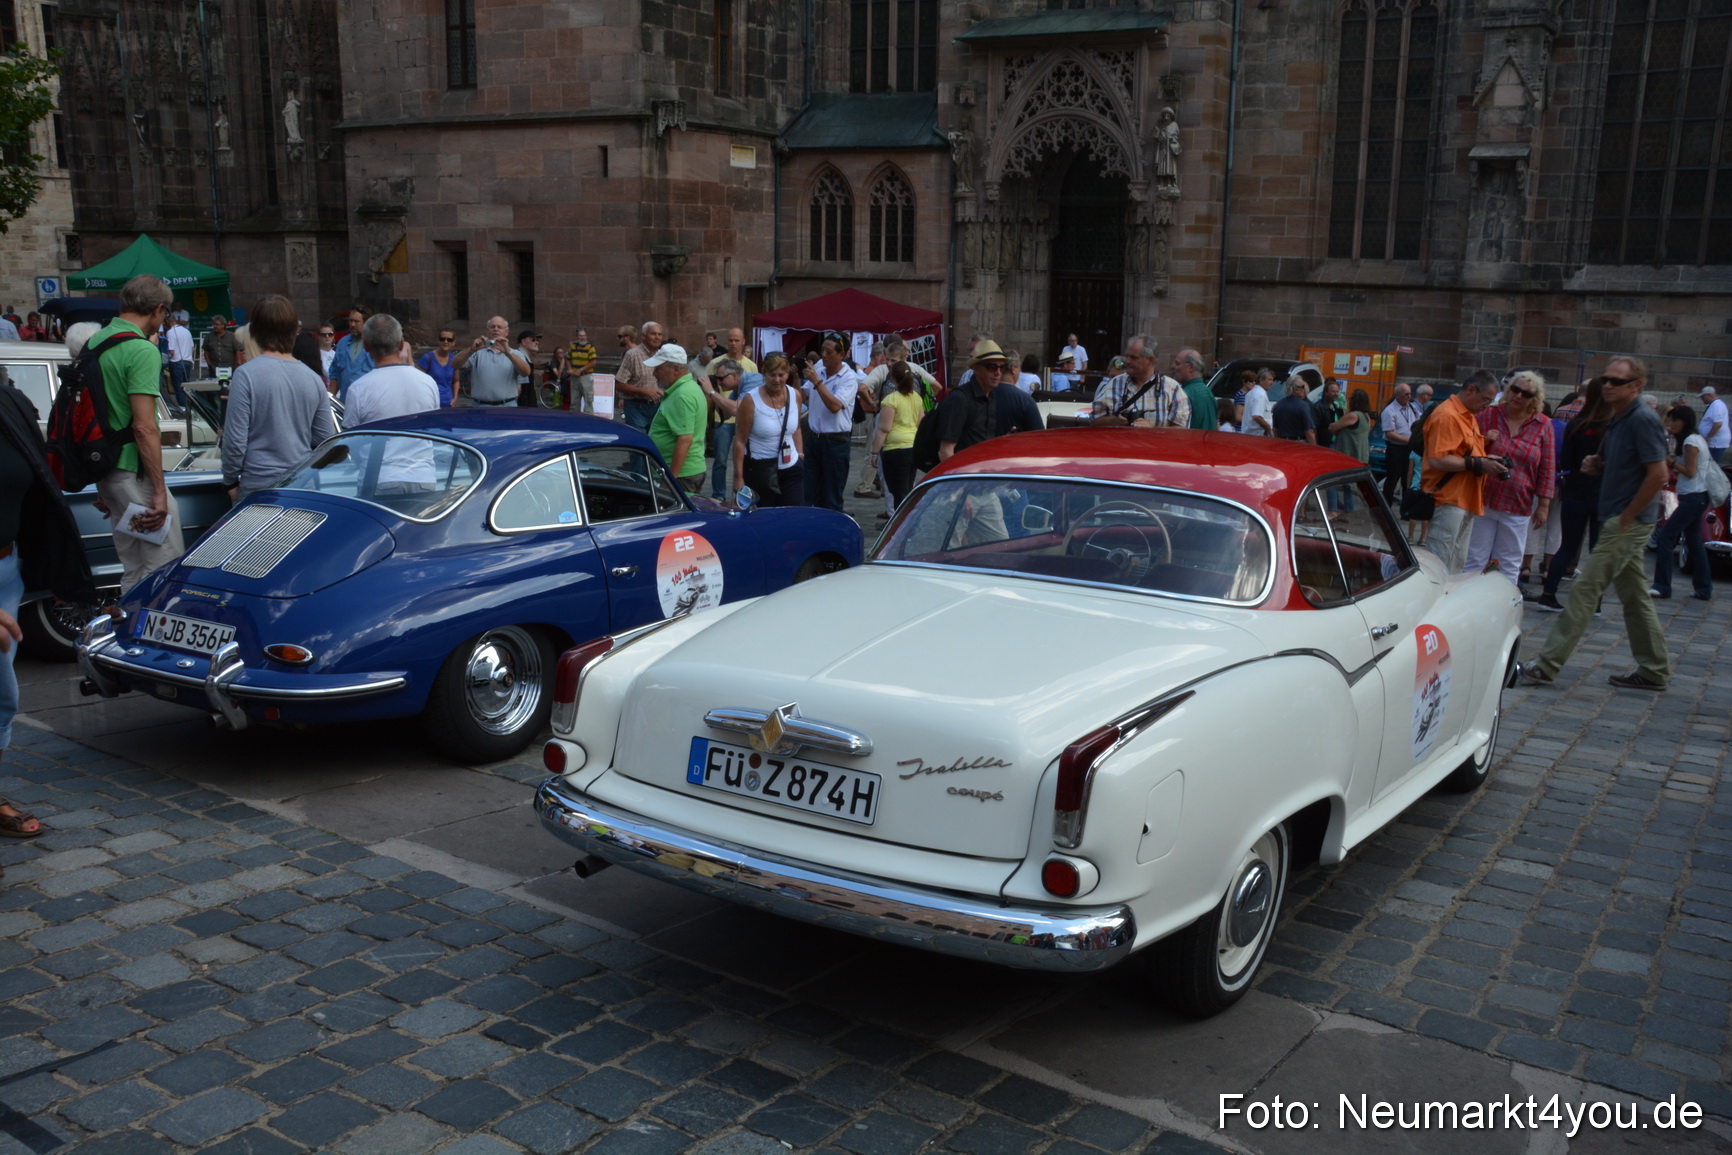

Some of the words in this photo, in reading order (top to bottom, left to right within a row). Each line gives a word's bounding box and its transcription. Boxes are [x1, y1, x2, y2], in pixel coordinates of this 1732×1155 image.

[91, 279, 107, 288] DEKRA
[173, 276, 199, 286] DEKRA
[673, 535, 695, 552] 22
[181, 588, 220, 600] PORSCHE
[143, 614, 157, 637] N
[164, 619, 186, 643] JB
[187, 624, 232, 650] 356H
[1422, 630, 1438, 656] 20
[692, 764, 701, 776] D
[897, 756, 1012, 780] Isabella
[705, 746, 745, 788] FÜ
[762, 759, 785, 797] Z
[787, 765, 875, 818] 874H
[946, 786, 1004, 803] coupé
